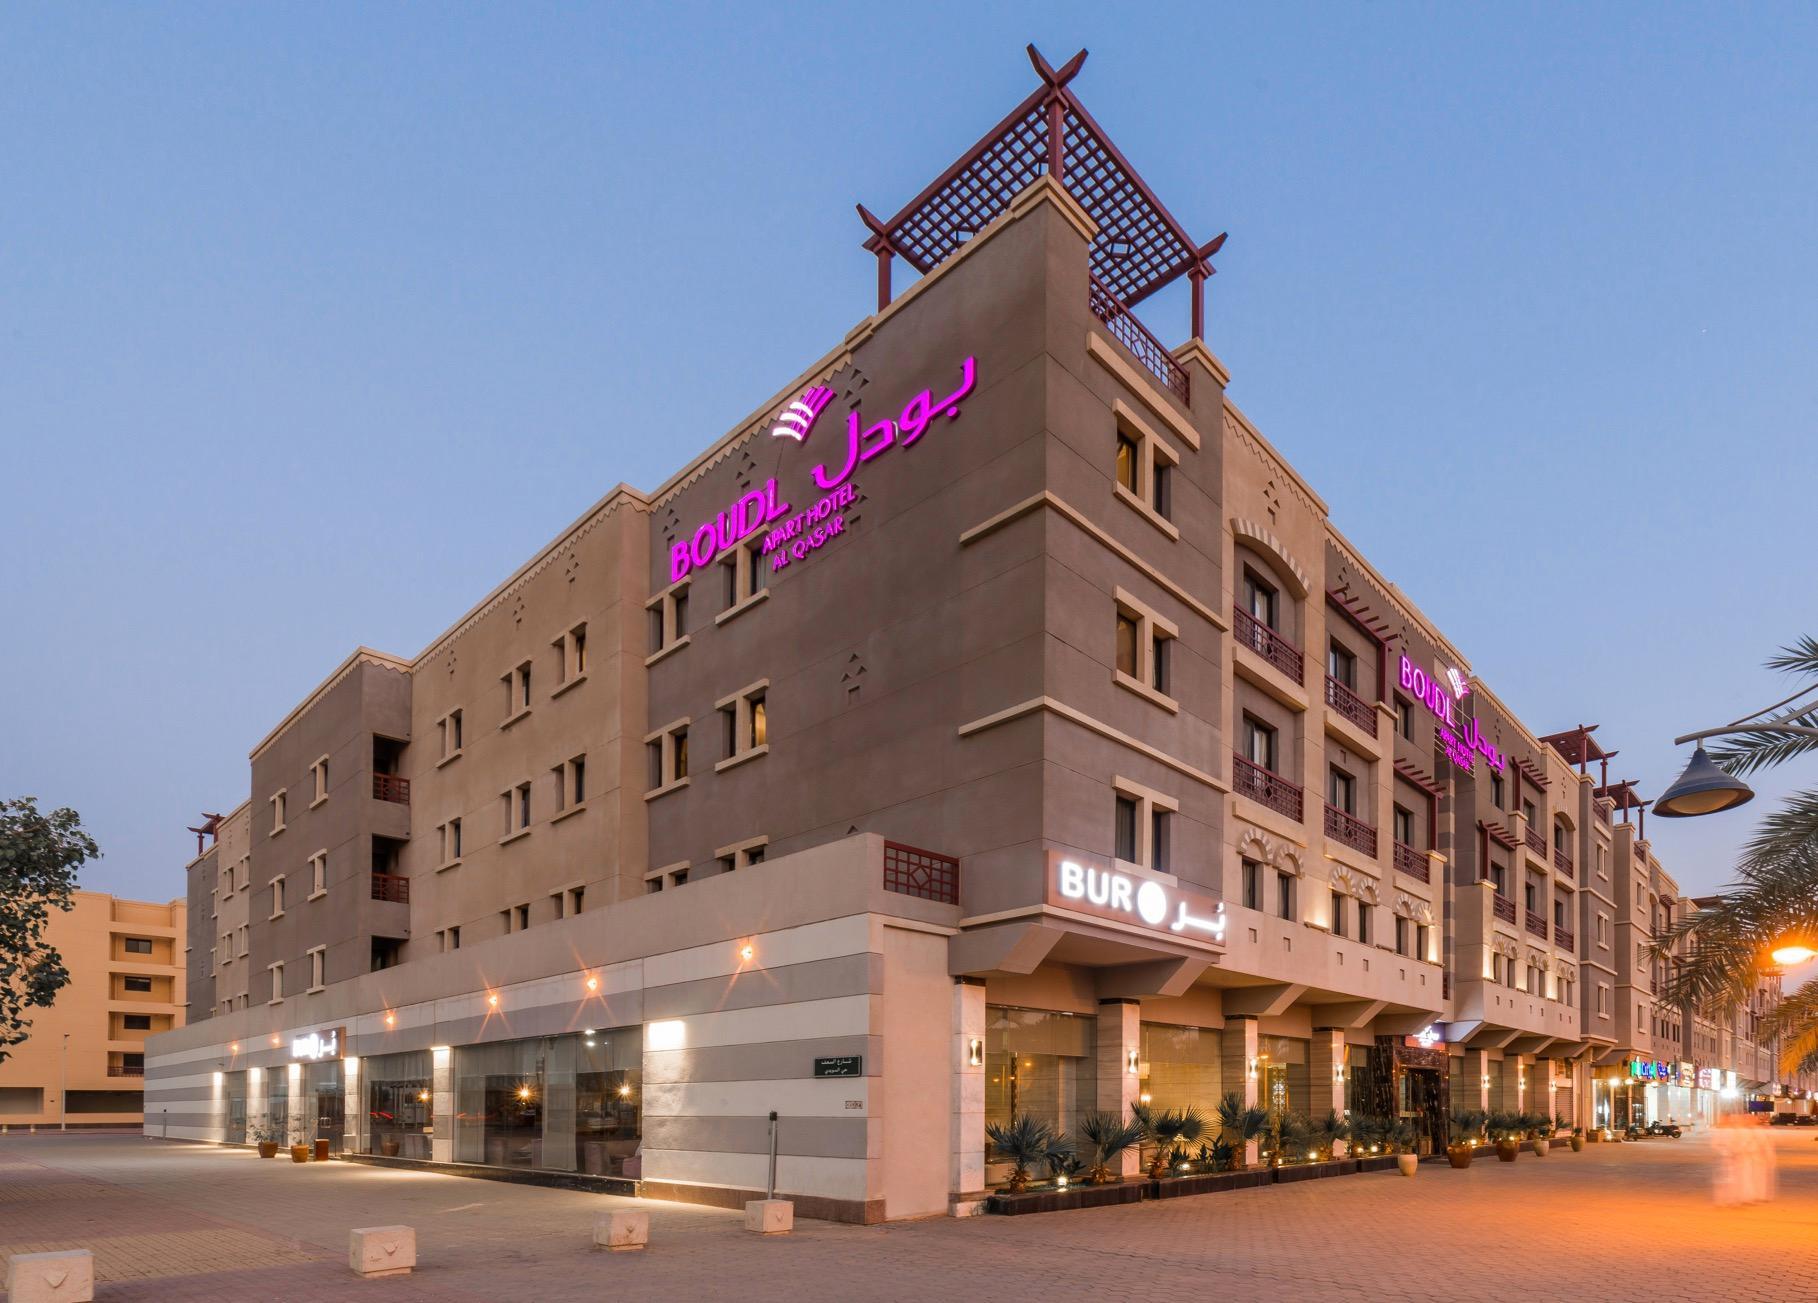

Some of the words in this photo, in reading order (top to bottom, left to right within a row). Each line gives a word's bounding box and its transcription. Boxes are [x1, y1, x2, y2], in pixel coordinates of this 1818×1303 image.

[810, 355, 978, 490] بودل
[671, 477, 792, 583] BOUDL
[762, 512, 806, 556] APART
[805, 482, 857, 528] HOTEL
[772, 548, 790, 572] AL
[792, 514, 845, 559] QASAR
[1400, 655, 1456, 729] BOUDL
